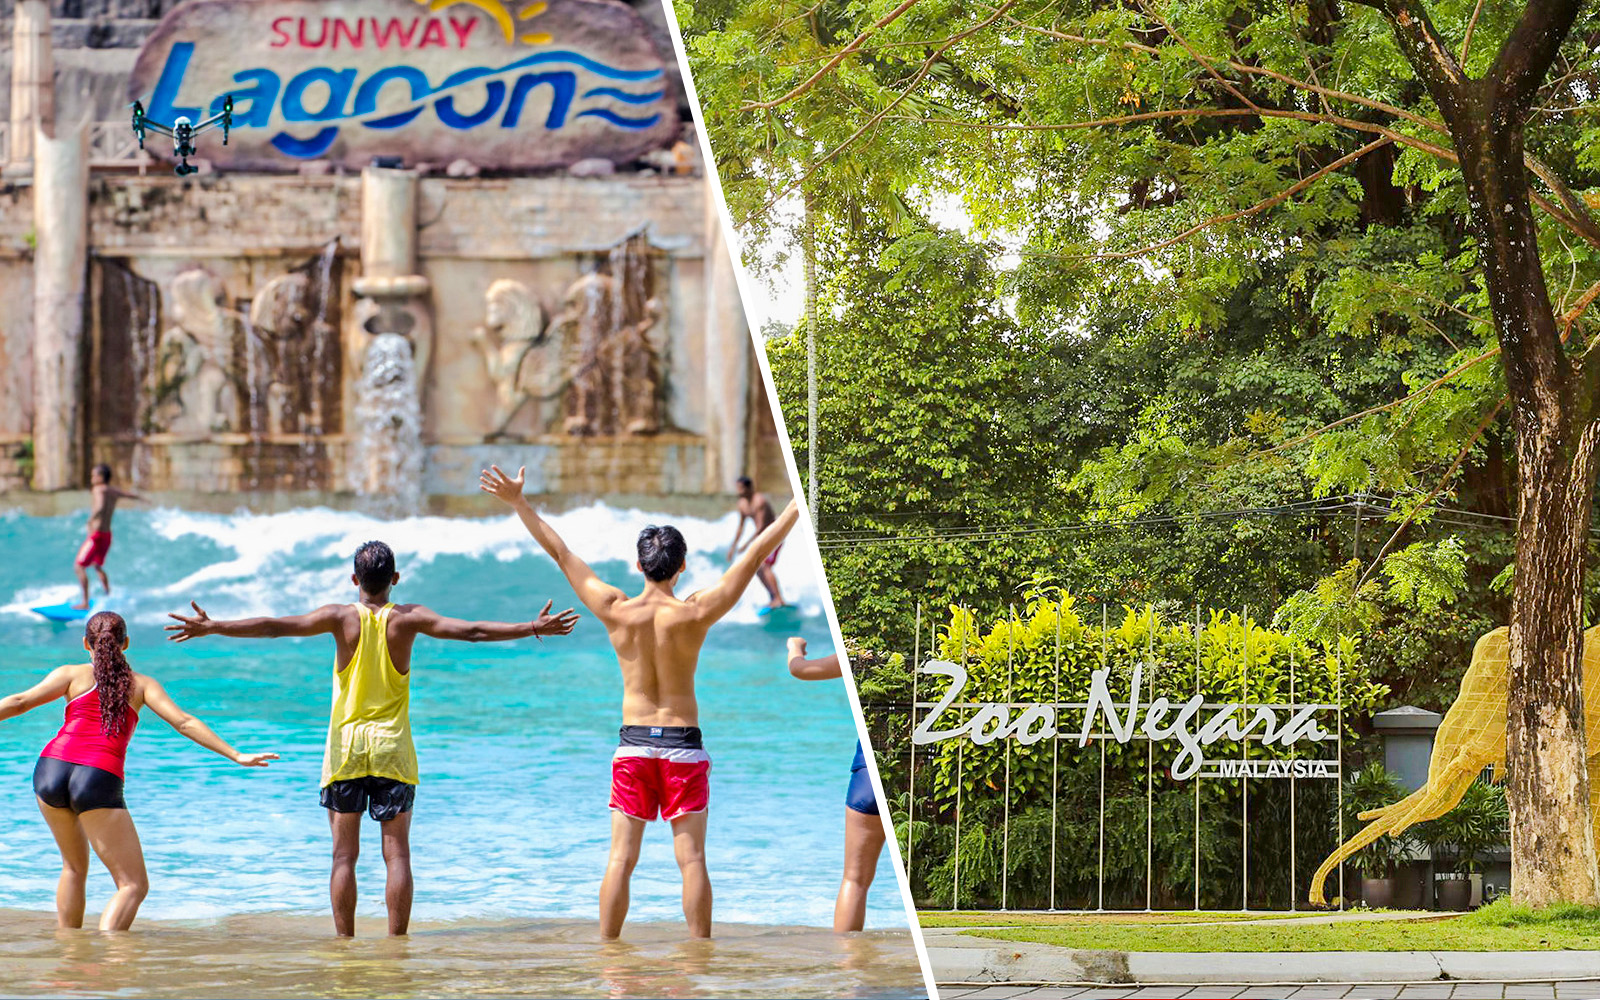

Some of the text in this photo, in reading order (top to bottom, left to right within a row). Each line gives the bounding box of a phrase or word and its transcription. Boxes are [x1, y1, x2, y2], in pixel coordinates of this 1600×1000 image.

[271, 17, 478, 49] SUNWAY
[147, 41, 577, 158] Lagoon
[912, 661, 1329, 781] Zoo Negara
[1219, 759, 1329, 778] MALAYSIA
